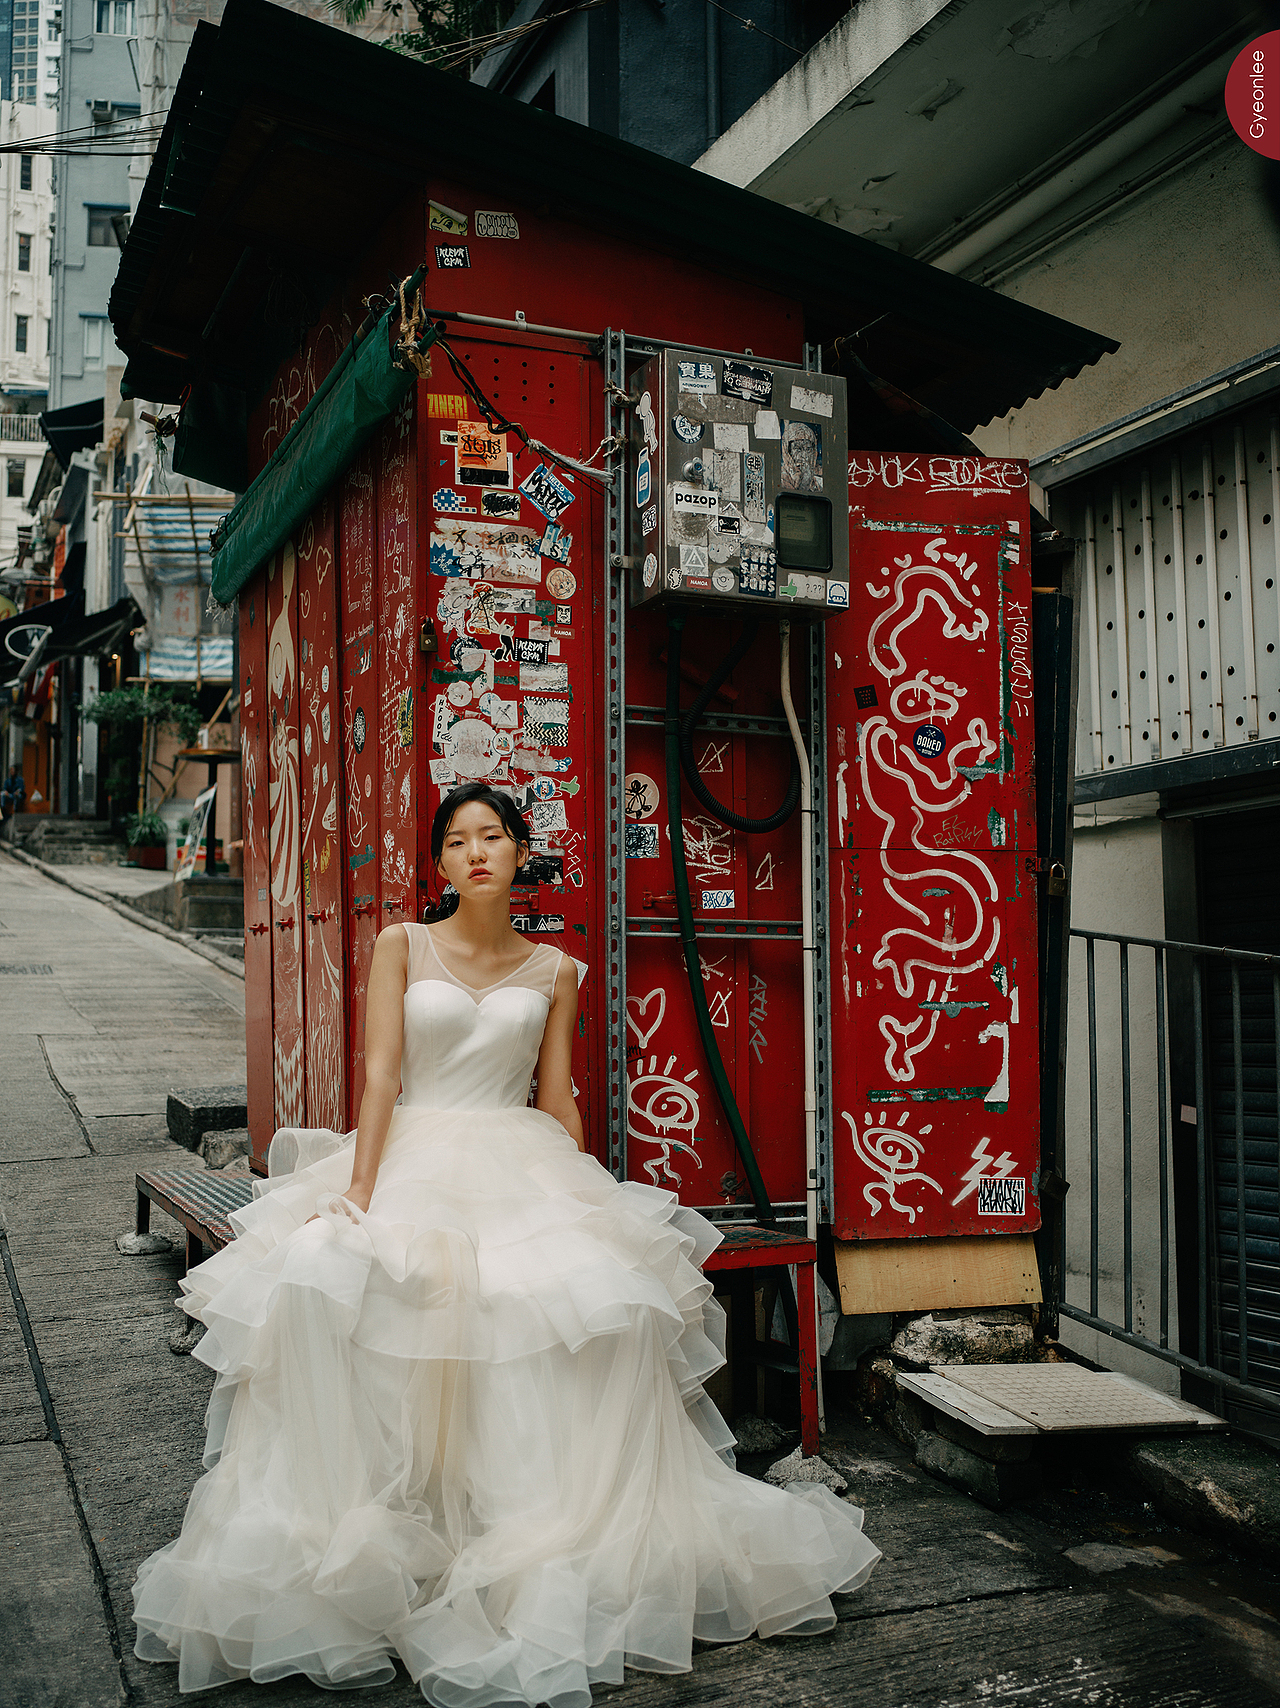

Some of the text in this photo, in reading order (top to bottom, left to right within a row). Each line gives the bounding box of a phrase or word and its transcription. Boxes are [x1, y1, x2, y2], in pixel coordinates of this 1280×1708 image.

[427, 394, 468, 419] ZINER!
[675, 492, 717, 509] pazop
[916, 734, 942, 752] BAKED
